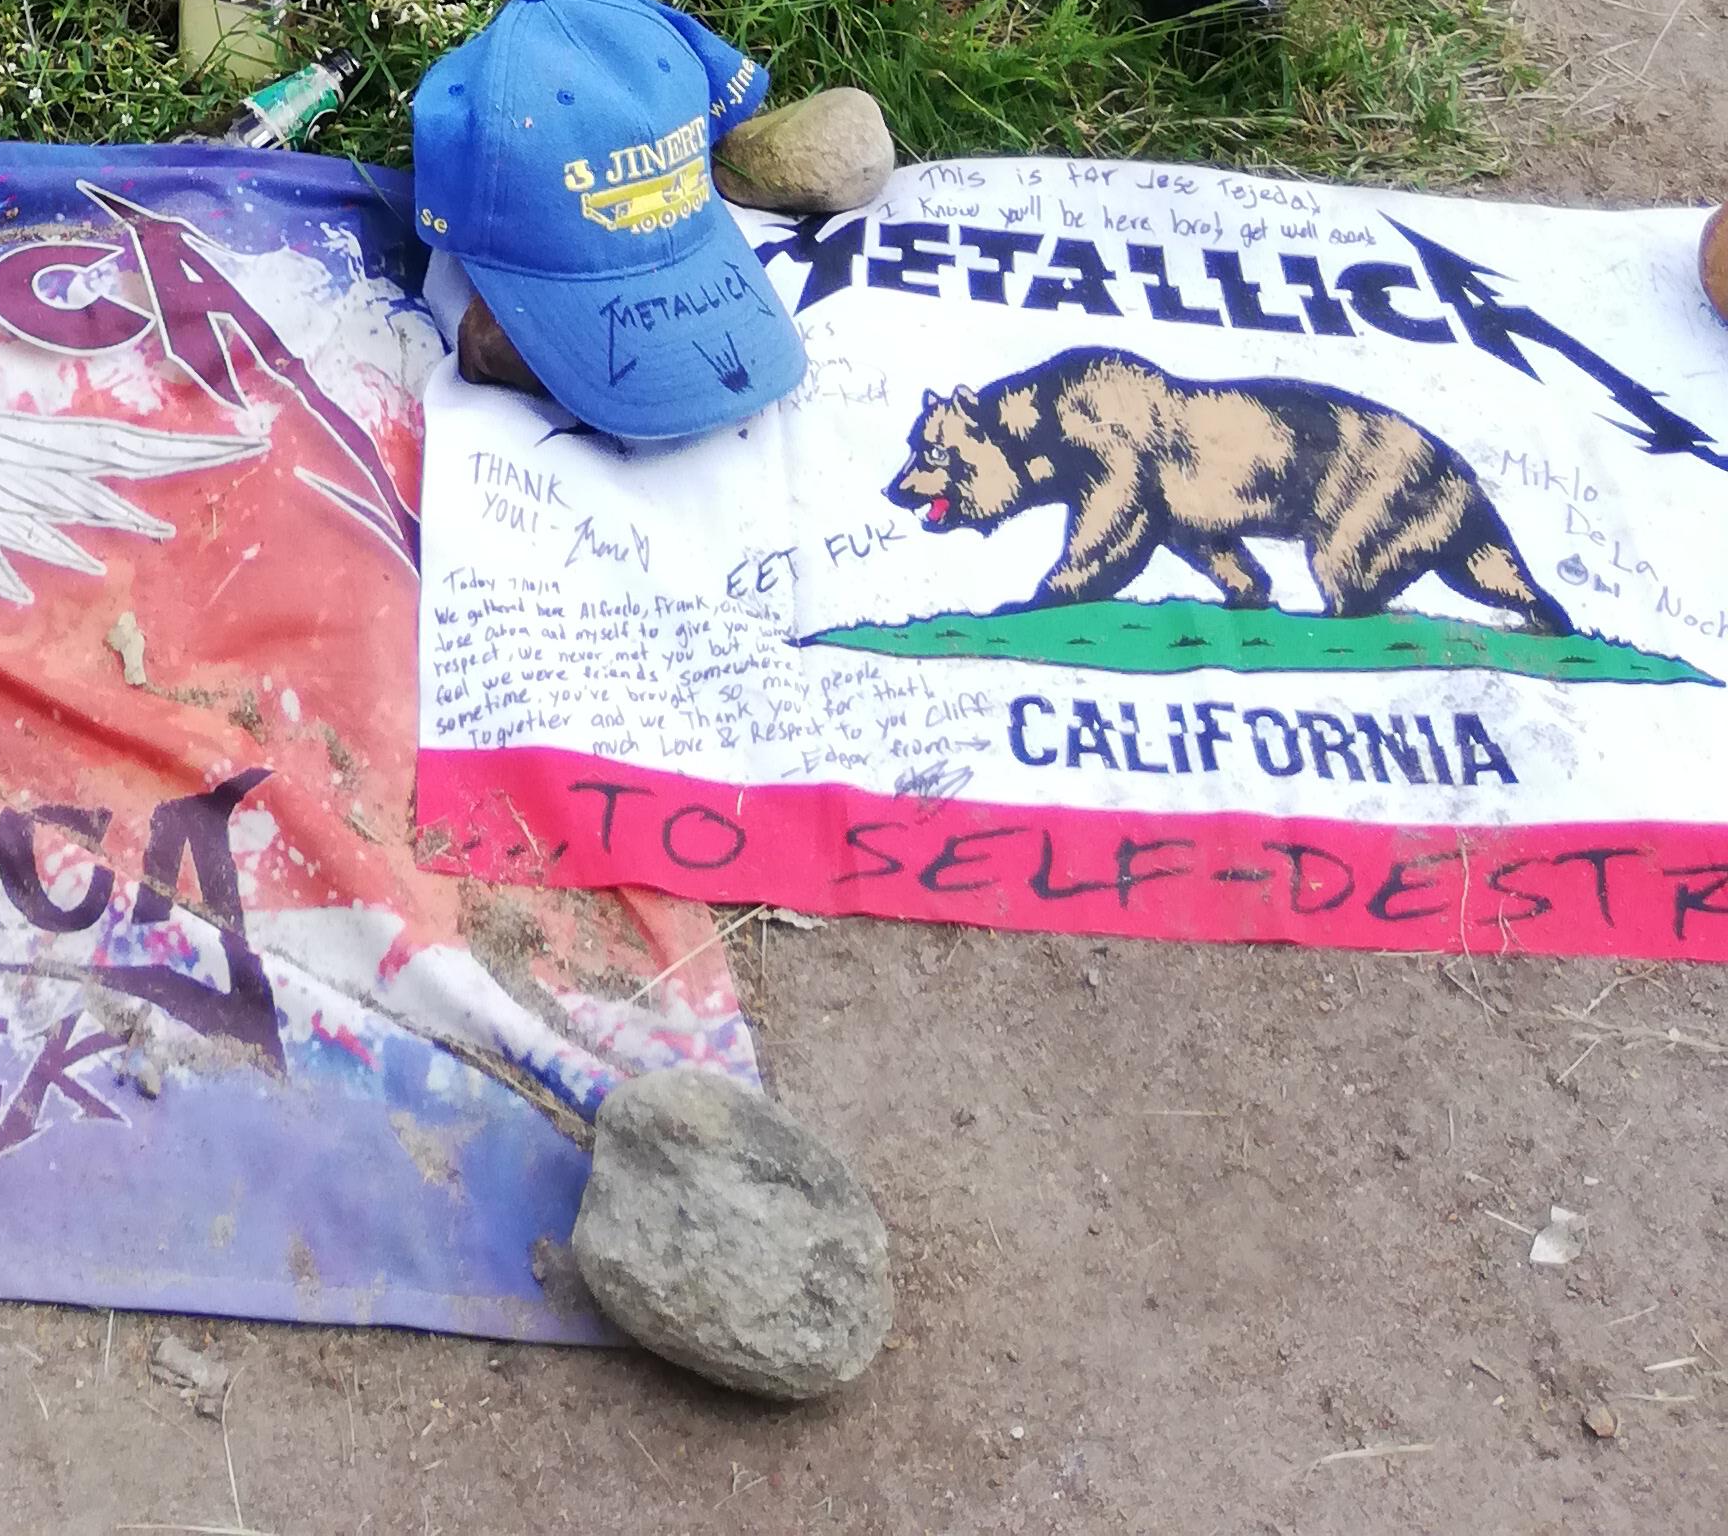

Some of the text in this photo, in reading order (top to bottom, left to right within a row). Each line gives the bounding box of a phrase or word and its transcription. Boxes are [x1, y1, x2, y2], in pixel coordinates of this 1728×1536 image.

[919, 164, 986, 192] This
[1016, 167, 1043, 186] is
[1068, 164, 1115, 186] for
[1059, 198, 1085, 228] be
[600, 261, 775, 388] METALLICA
[754, 208, 1728, 473] METALLICA
[468, 450, 574, 511] THANK
[590, 704, 626, 729] and
[1006, 693, 1520, 786] CALIFORNIA
